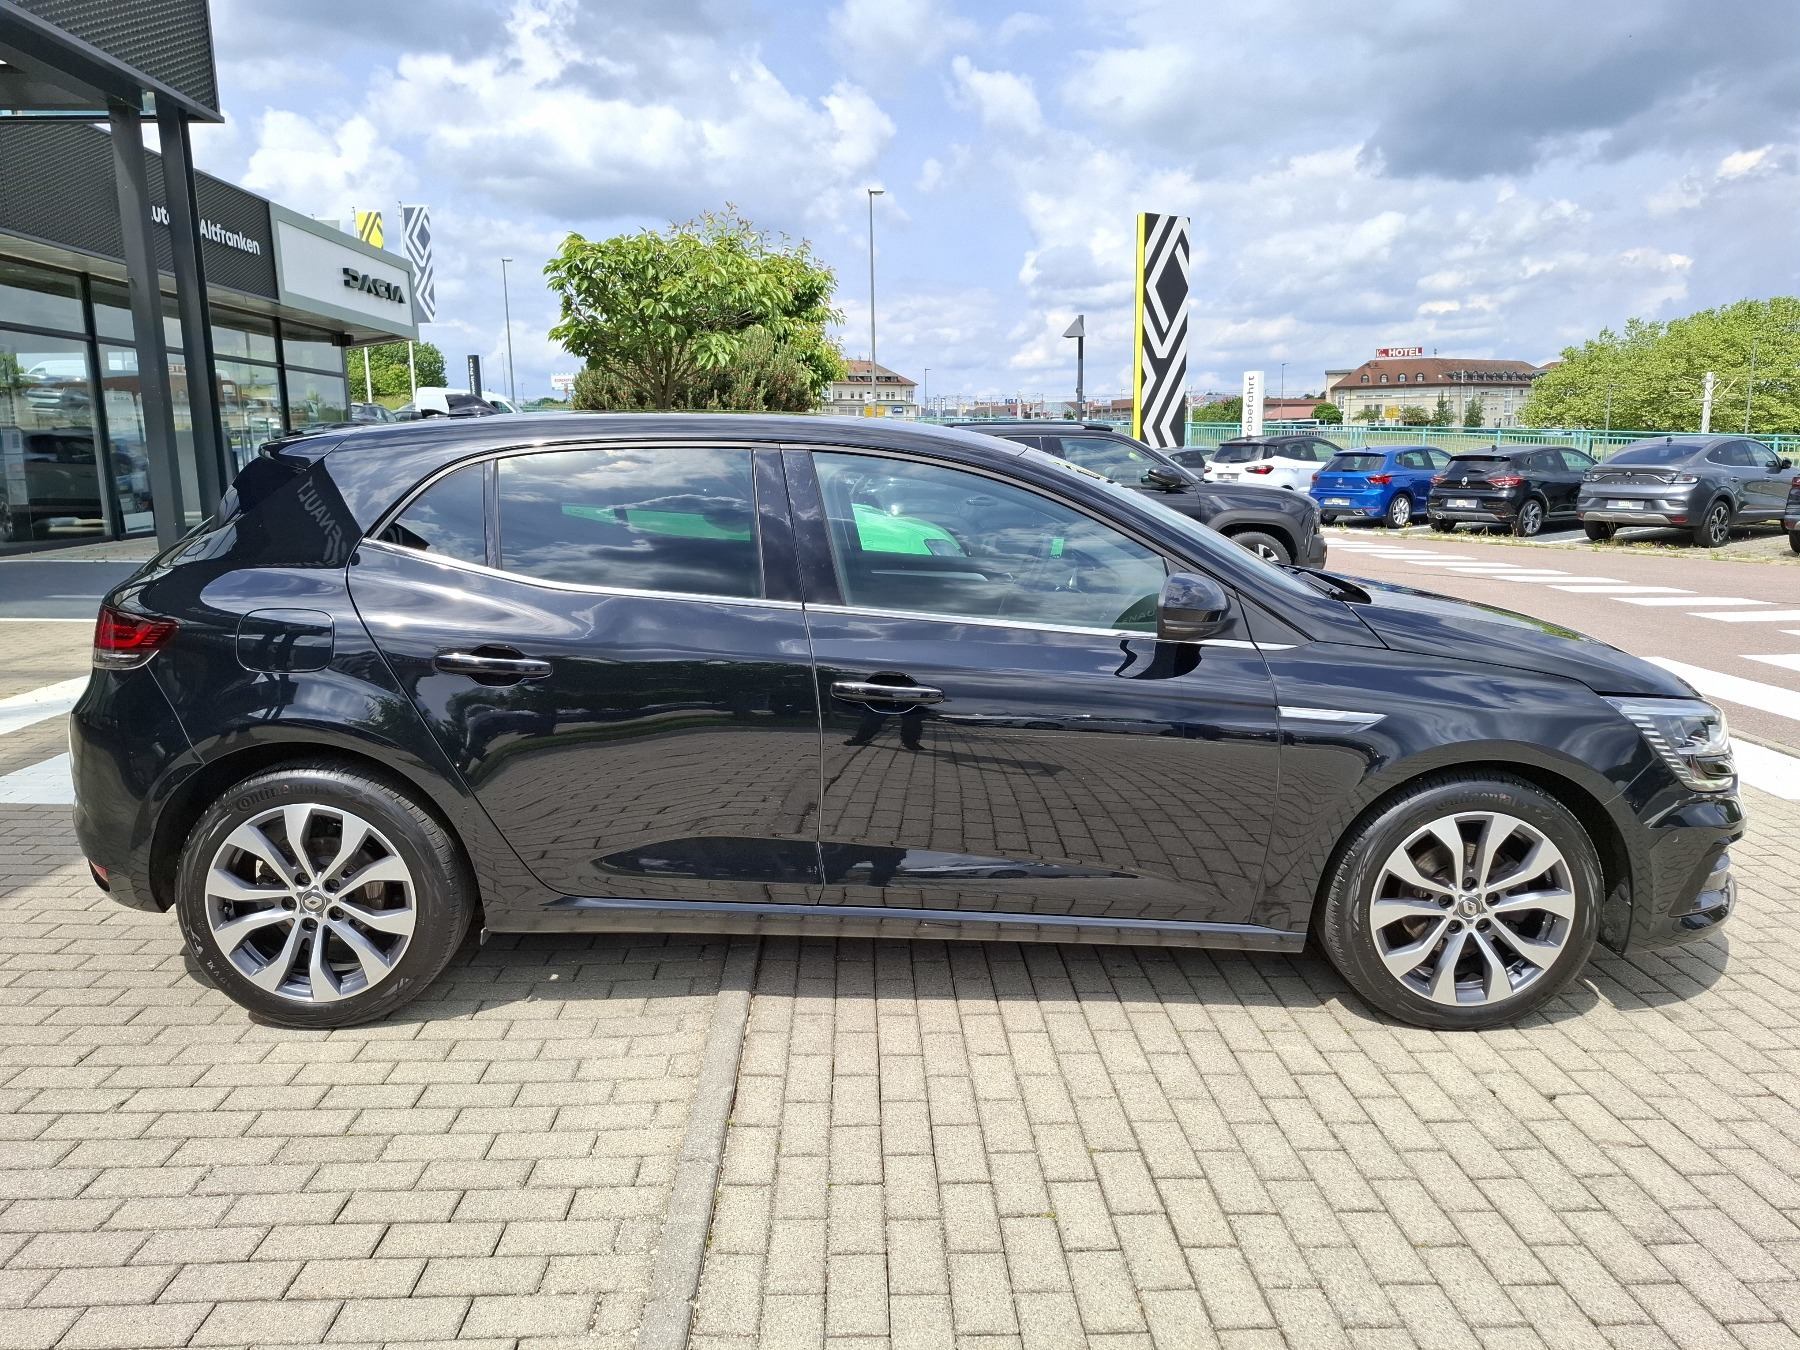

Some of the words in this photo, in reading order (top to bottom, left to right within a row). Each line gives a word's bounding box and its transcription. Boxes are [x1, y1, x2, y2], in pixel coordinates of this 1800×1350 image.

[151, 205, 169, 225] ut
[200, 218, 260, 255] Altfranken
[342, 267, 406, 304] DACIA
[1388, 347, 1422, 357] HOTEL
